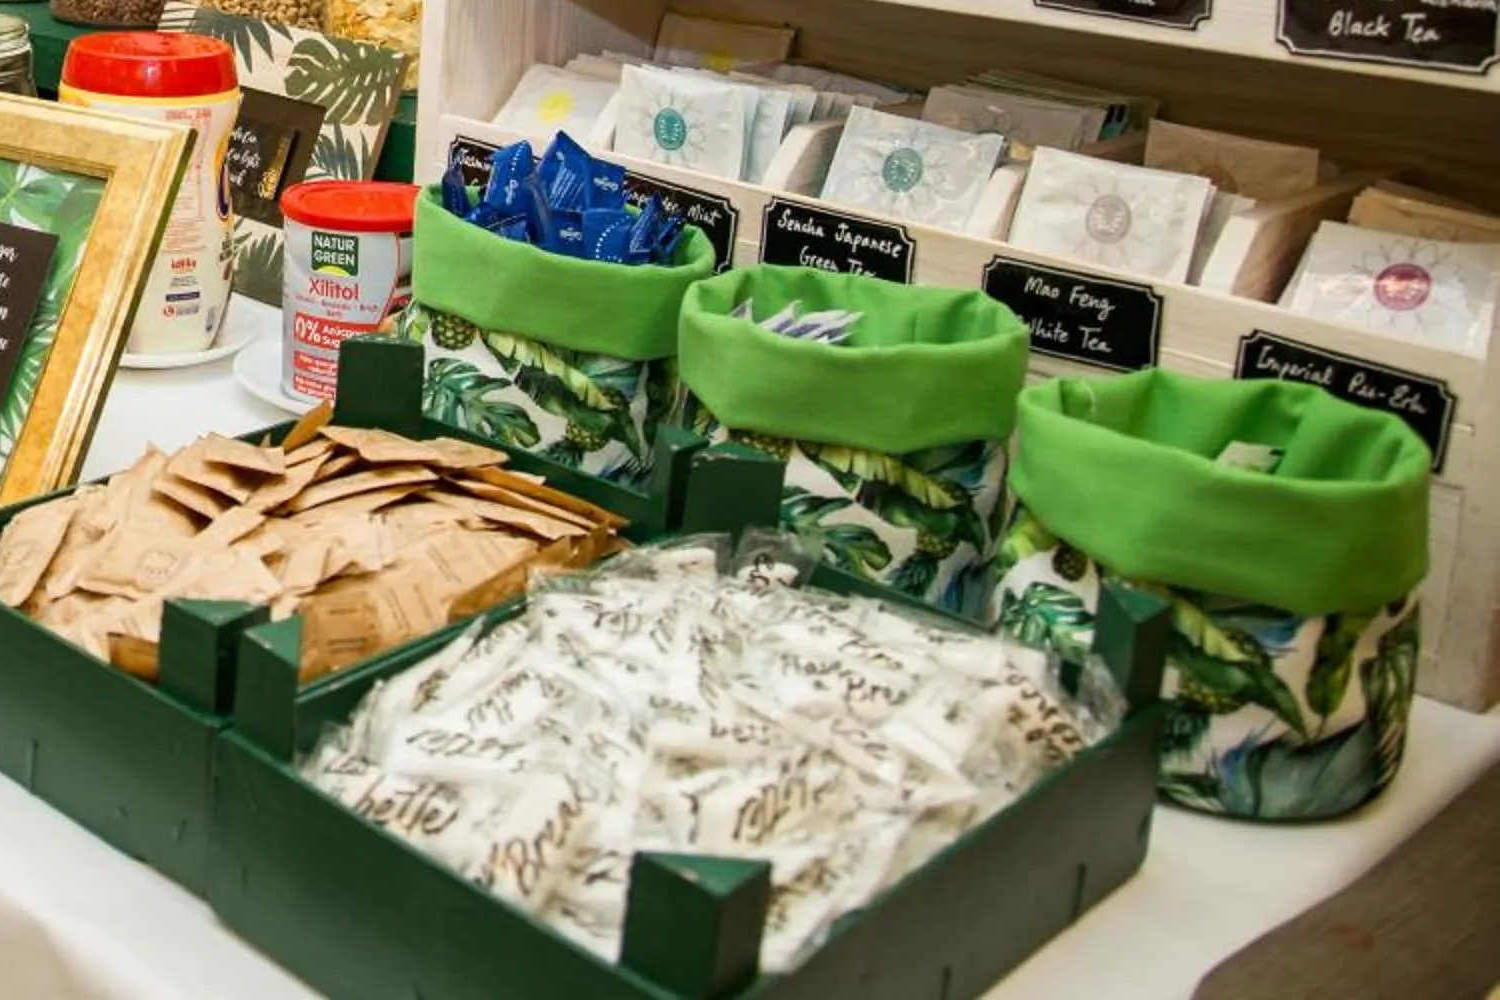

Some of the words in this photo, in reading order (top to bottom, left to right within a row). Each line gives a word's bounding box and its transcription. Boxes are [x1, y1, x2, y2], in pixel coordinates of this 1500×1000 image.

[1328, 9, 1390, 37] Black
[1401, 13, 1441, 43] Tea
[314, 234, 355, 251] NATUR
[776, 208, 825, 238] Sencha
[835, 222, 903, 258] Japanese
[314, 250, 356, 267] GREEN
[799, 245, 840, 273] Green
[309, 277, 360, 301] Xilitol
[1023, 276, 1060, 299] Mao
[1069, 285, 1116, 321] Feng
[1078, 325, 1113, 353] Tea
[1256, 345, 1334, 384] Imperial
